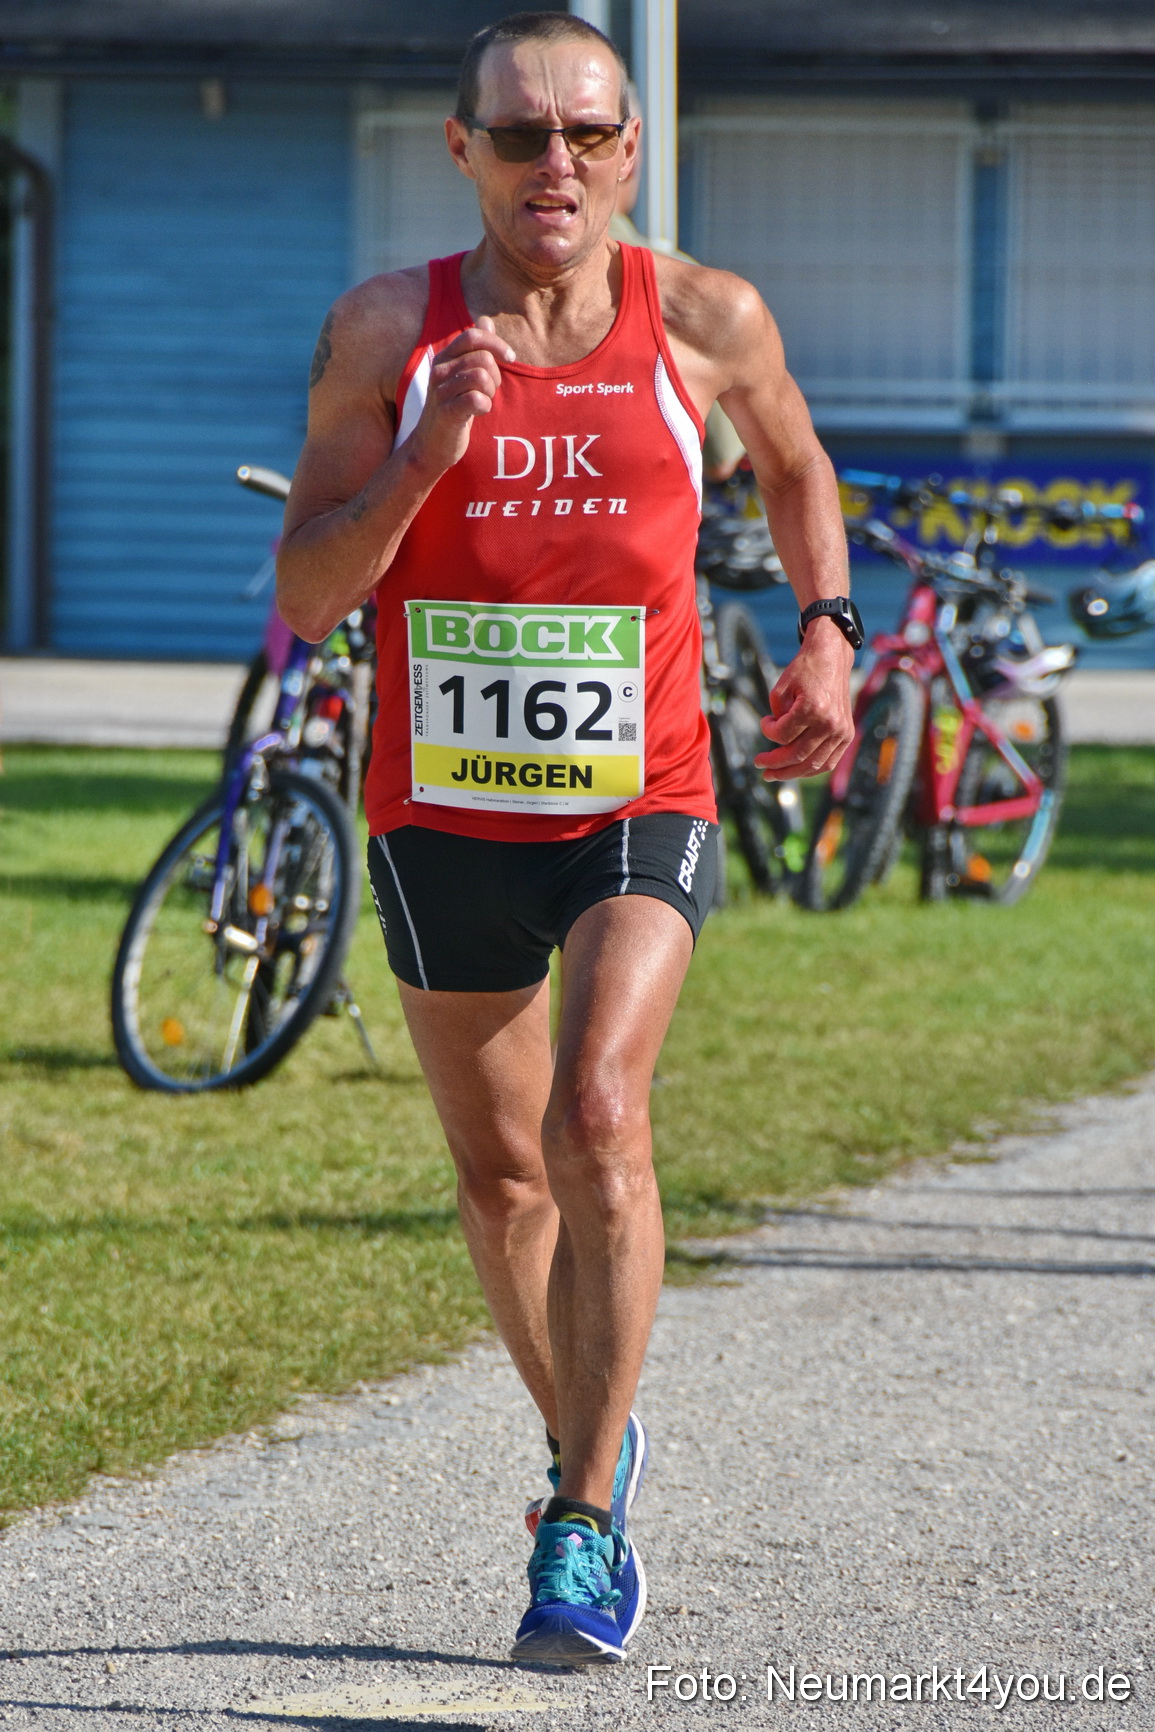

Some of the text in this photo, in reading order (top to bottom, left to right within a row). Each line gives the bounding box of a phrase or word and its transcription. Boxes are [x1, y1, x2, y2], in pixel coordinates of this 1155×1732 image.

[556, 382, 634, 397] Sport Sperk
[493, 434, 604, 491] DJK
[425, 609, 624, 660] BOCK
[438, 674, 613, 741] 1162
[622, 686, 633, 698] C
[451, 754, 593, 789] JÜRGEN
[678, 827, 701, 894] CRAFT
